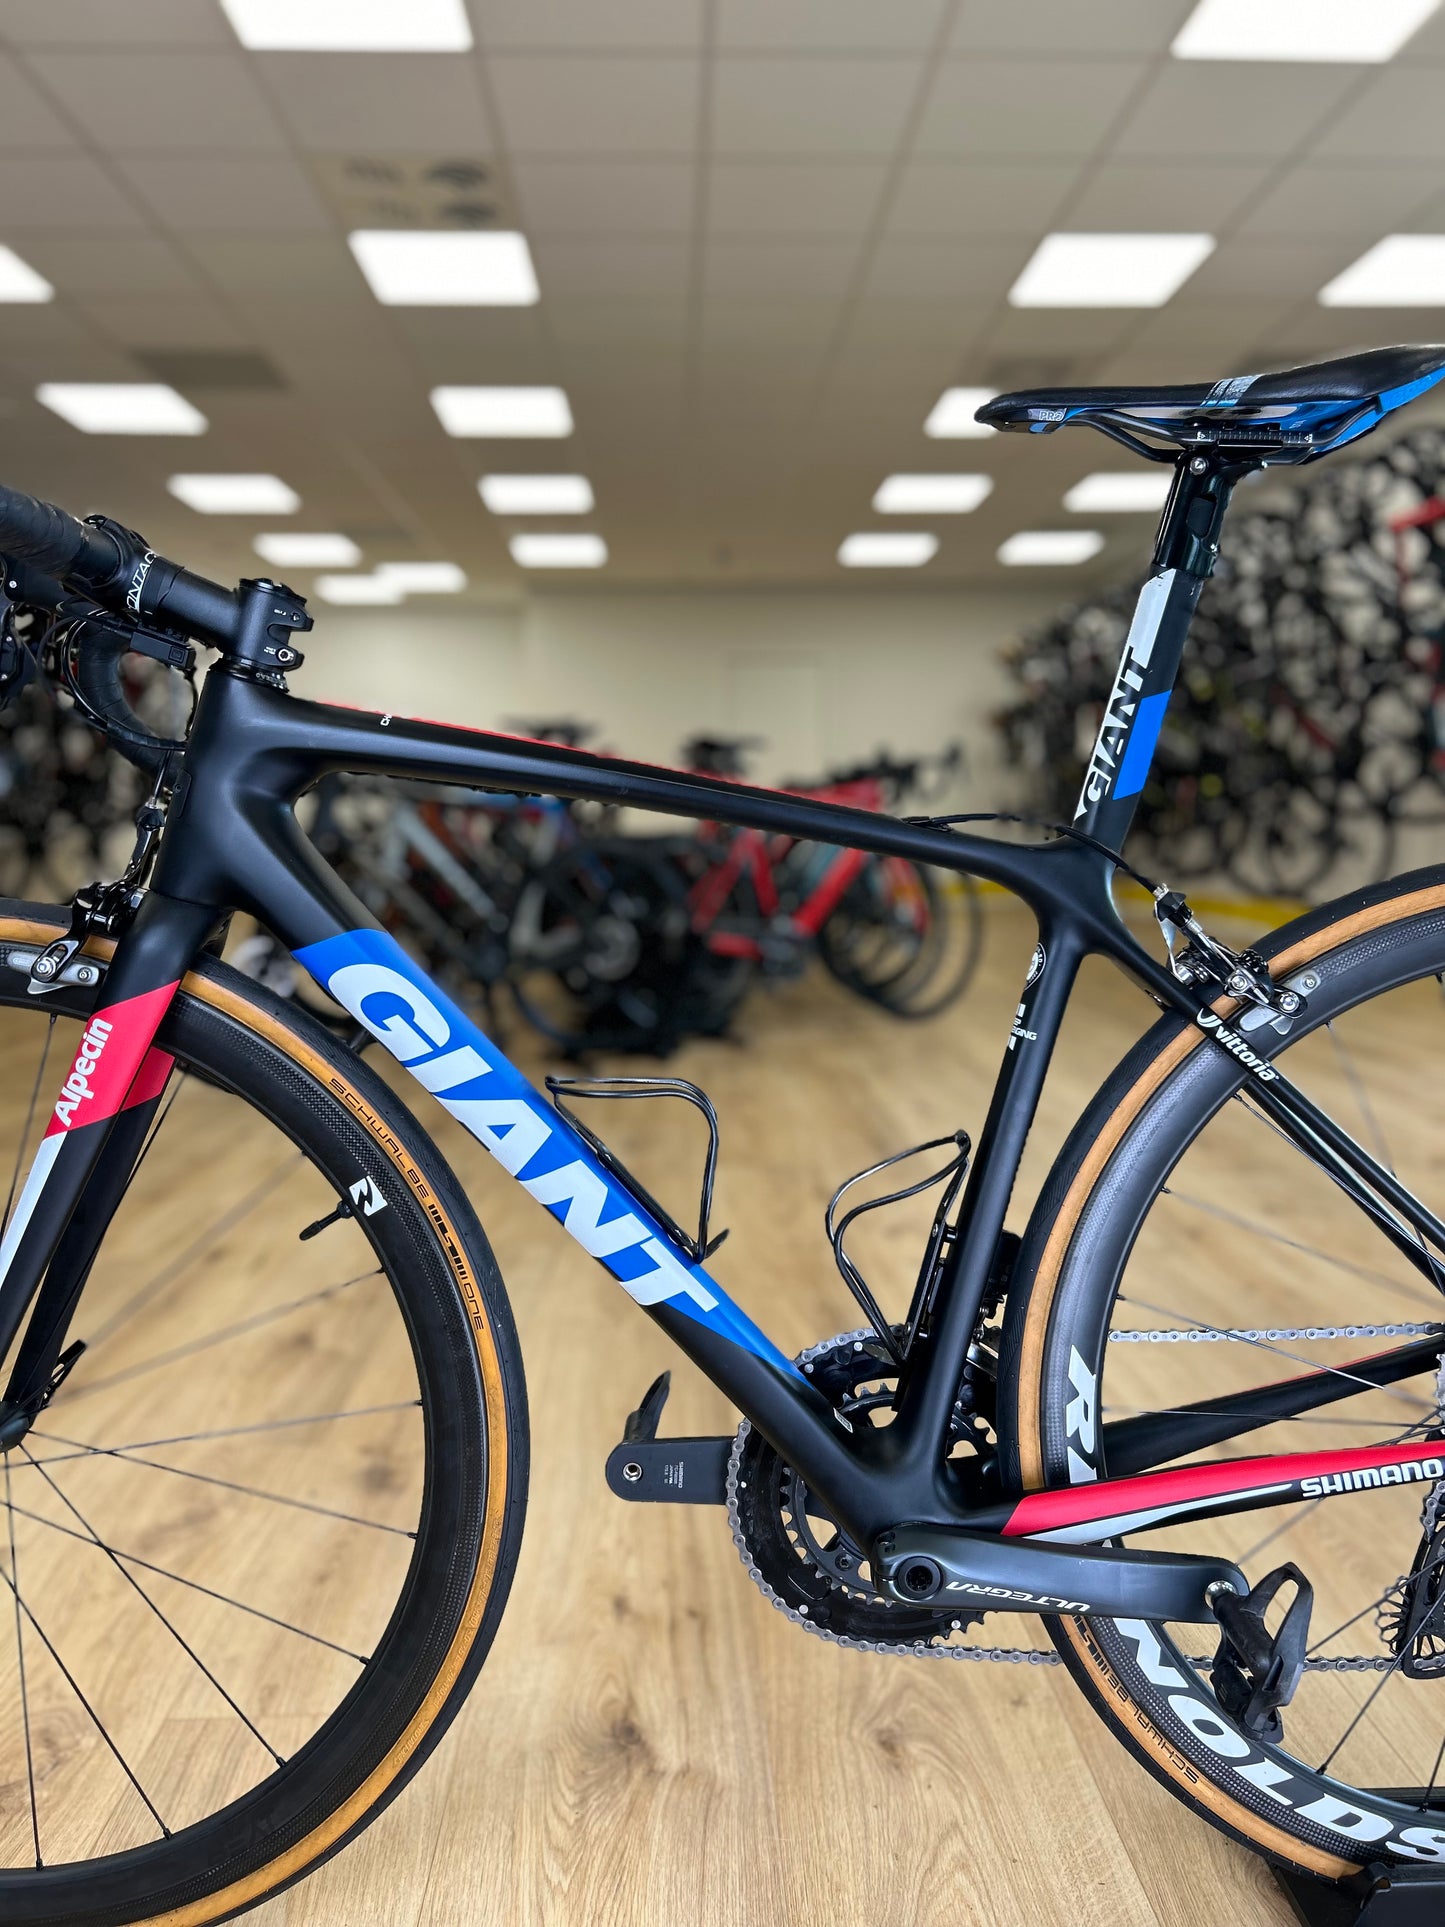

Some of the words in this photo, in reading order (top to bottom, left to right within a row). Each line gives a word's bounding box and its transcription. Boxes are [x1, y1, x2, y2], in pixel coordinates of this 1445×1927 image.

[1083, 645, 1147, 812] GIANT
[55, 1018, 113, 1127] Alpecin
[1215, 1026, 1277, 1081] vittoria
[328, 963, 720, 1312] GIANT
[329, 1078, 429, 1199] SCHWALBE
[464, 1283, 484, 1330] ONE
[1300, 1458, 1444, 1497] SHIMANO
[945, 1581, 1091, 1612] ULTEGRA
[1107, 1673, 1200, 1784] SCHWALBE
